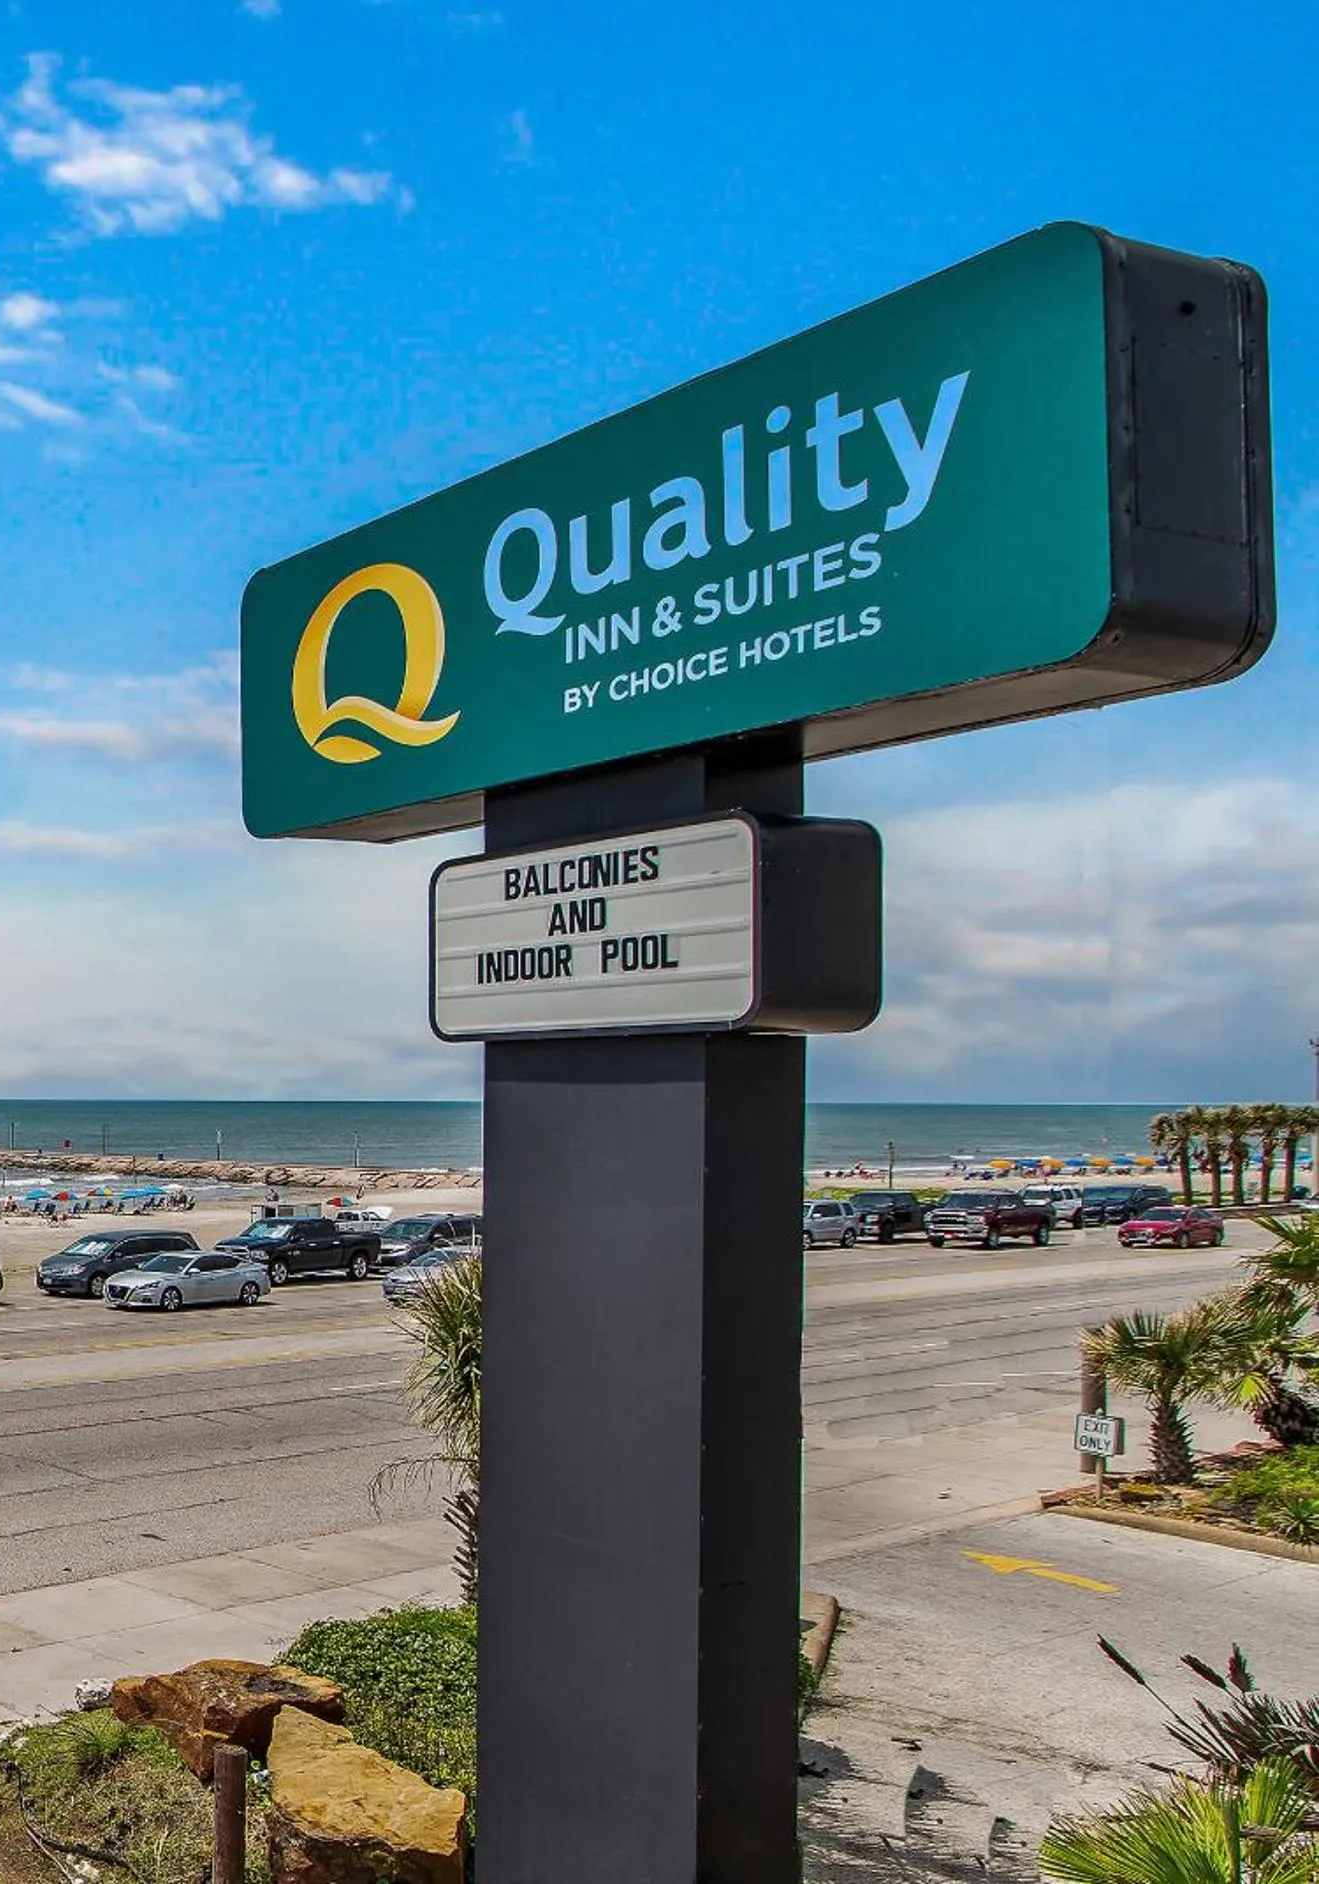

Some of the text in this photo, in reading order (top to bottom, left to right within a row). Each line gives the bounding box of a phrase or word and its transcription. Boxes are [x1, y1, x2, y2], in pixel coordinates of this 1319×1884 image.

[484, 371, 971, 636] Quality
[565, 532, 882, 664] INN & SUITES
[564, 606, 882, 714] BY CHOICE HOTELS
[504, 846, 659, 901] BALCONIES
[548, 897, 607, 936] AND
[477, 934, 678, 984] INDOOR POOL
[1080, 1435, 1111, 1451] ONLY
[1084, 1420, 1110, 1434] EXIT
